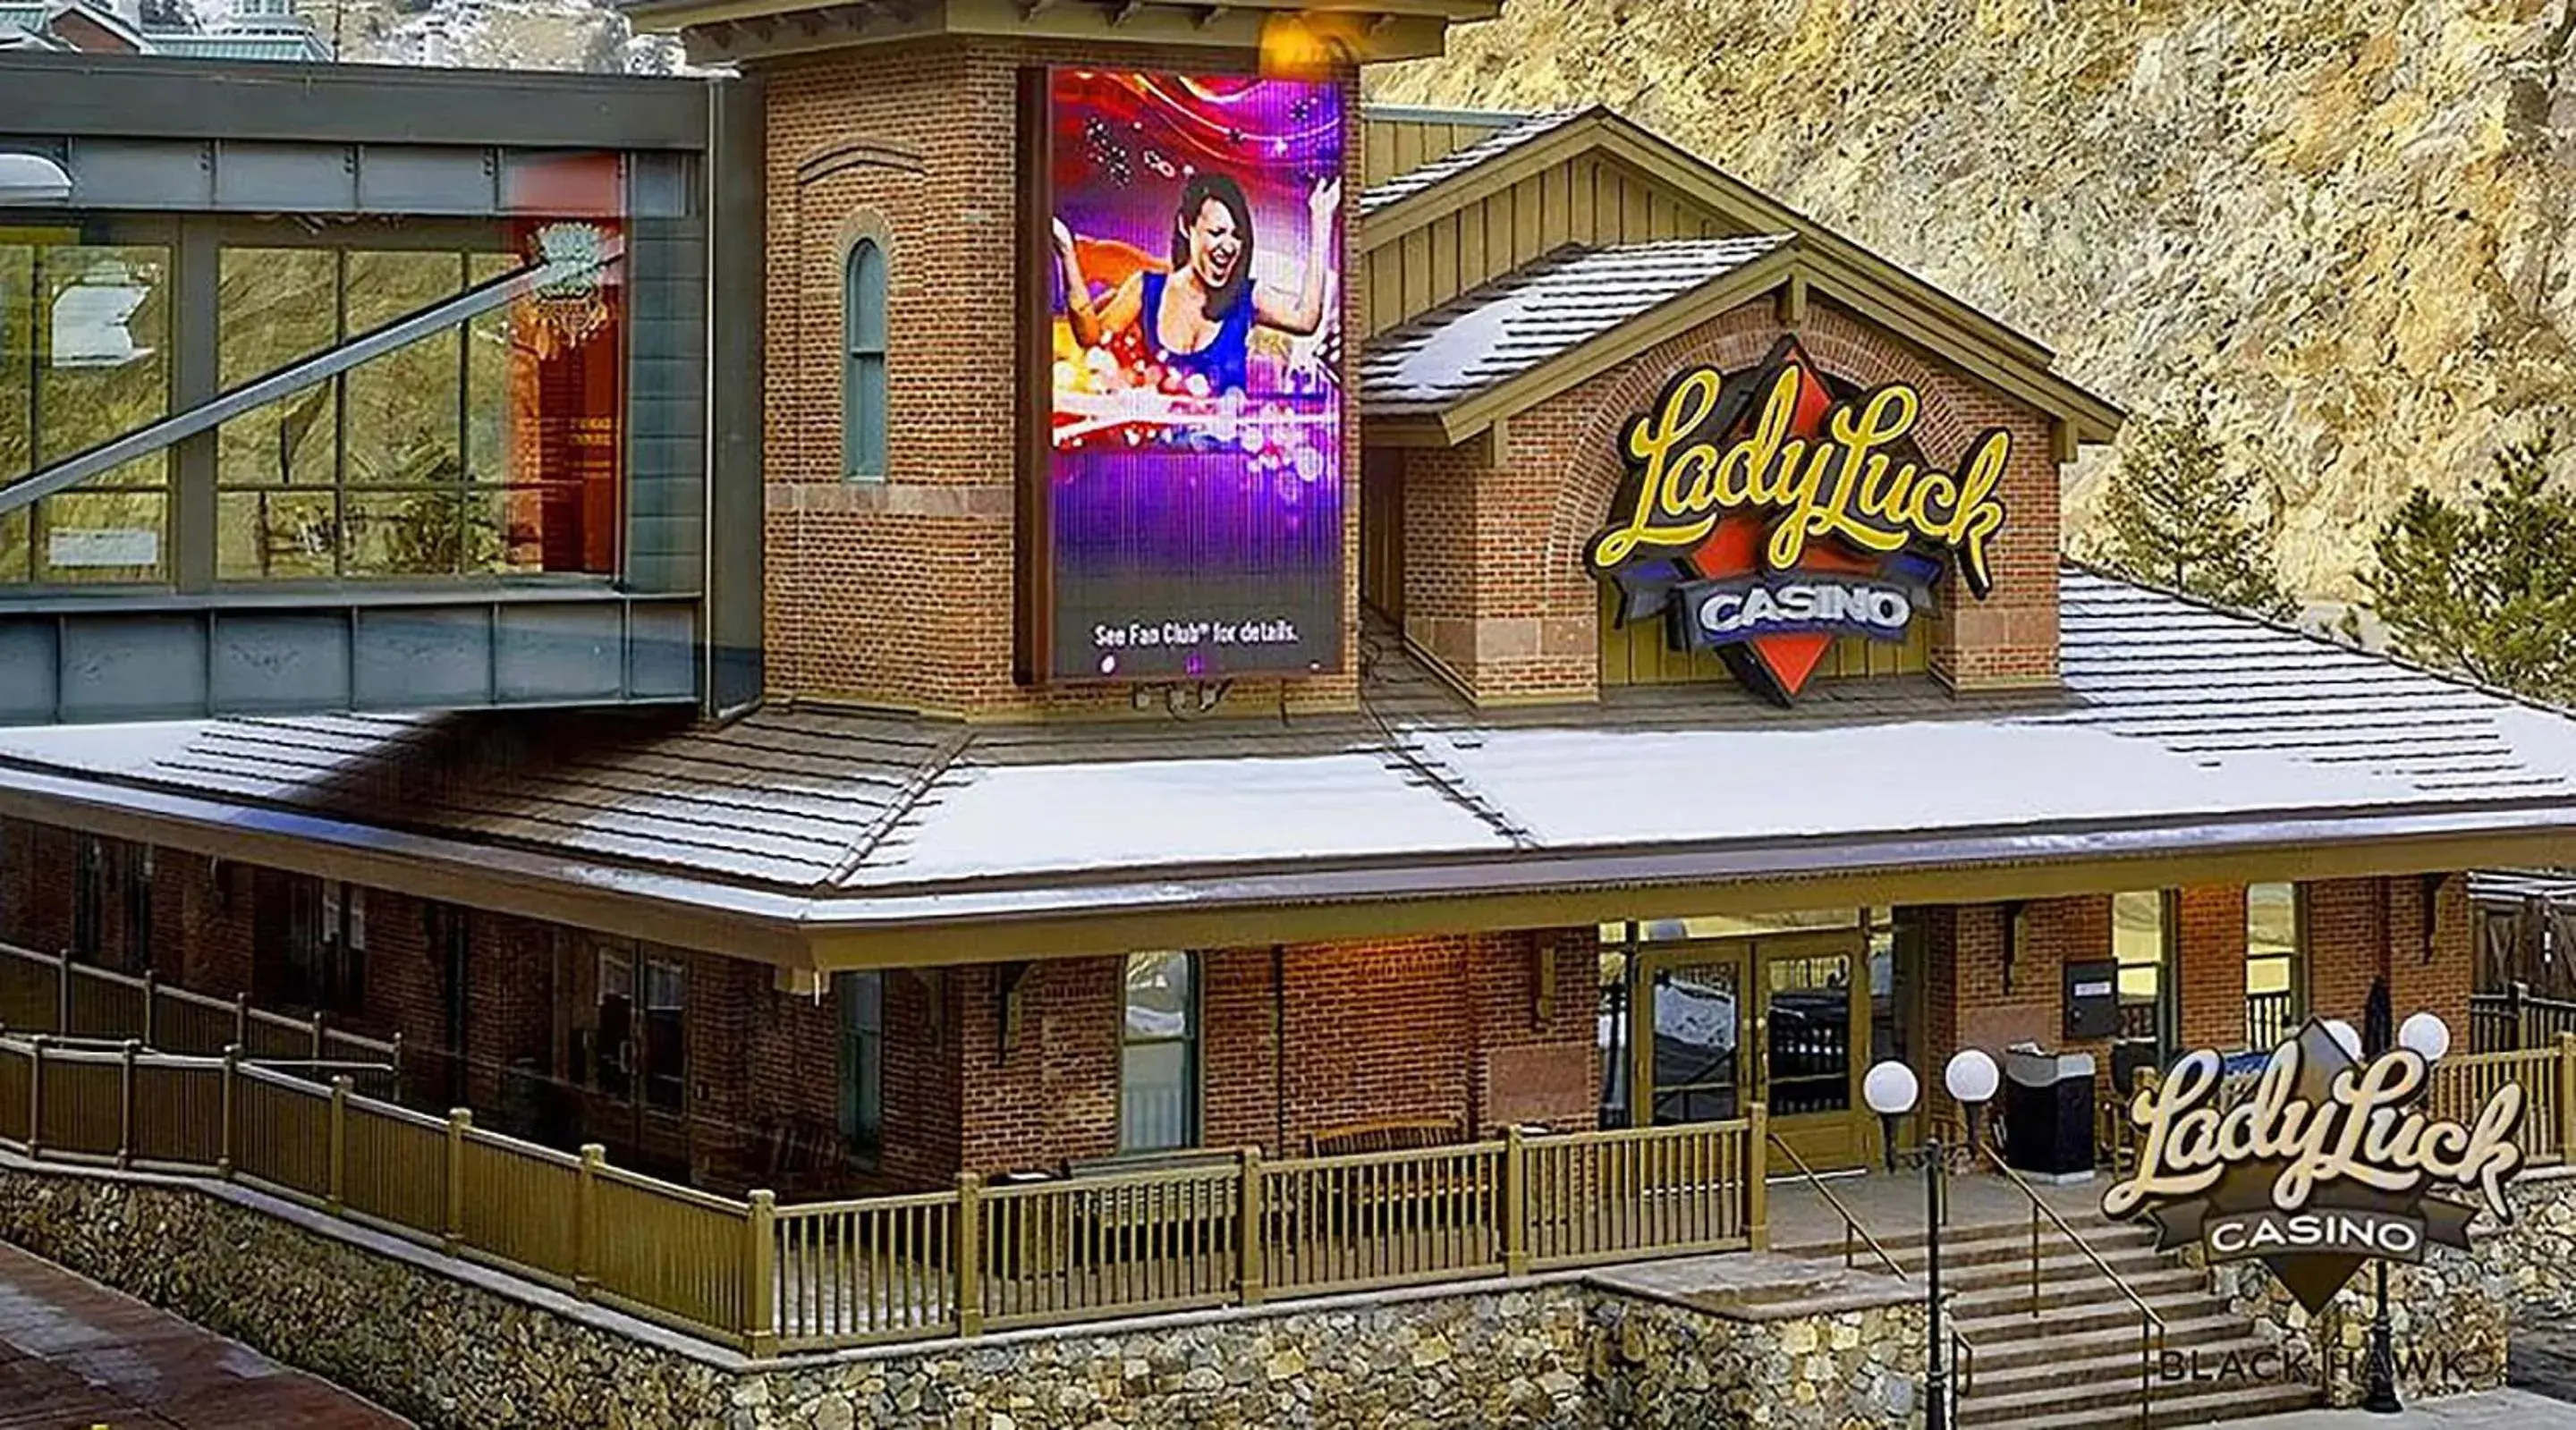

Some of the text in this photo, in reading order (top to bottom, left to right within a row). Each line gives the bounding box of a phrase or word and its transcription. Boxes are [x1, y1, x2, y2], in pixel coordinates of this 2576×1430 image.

[1699, 586, 1911, 630] CASINO
[1094, 625, 1125, 647] See
[1130, 624, 1160, 646] Fan
[1213, 622, 1235, 643] for
[1240, 621, 1299, 642] details.
